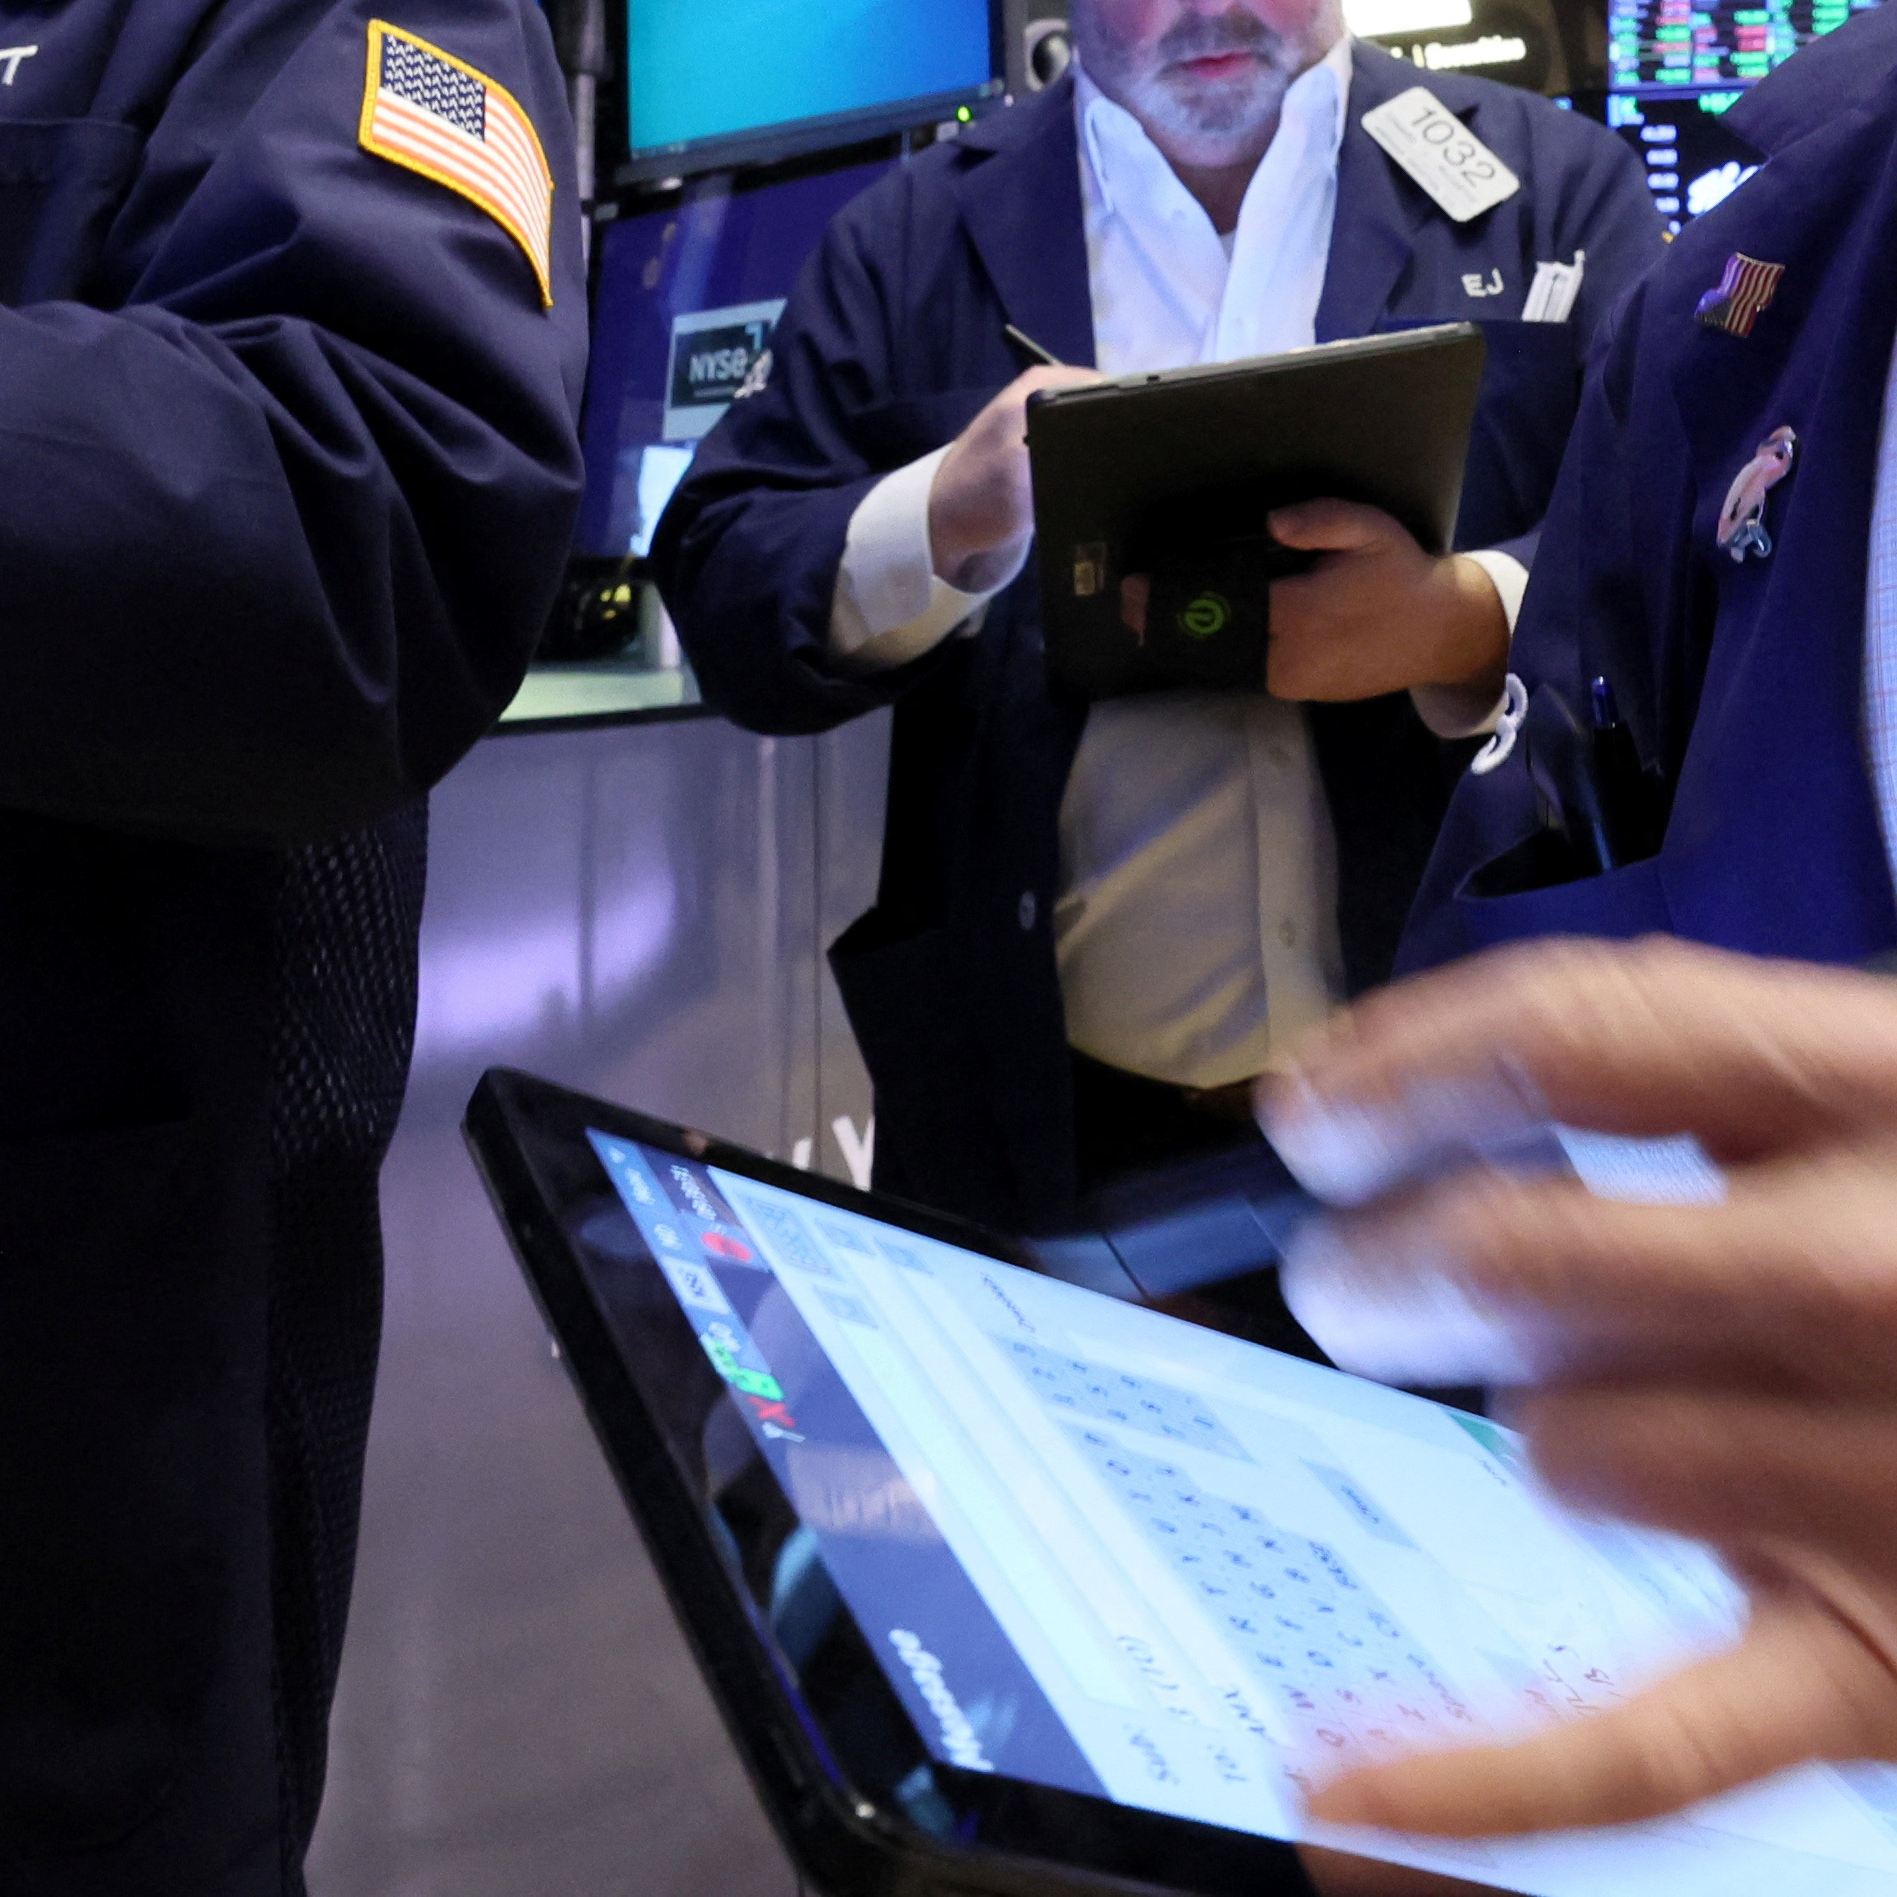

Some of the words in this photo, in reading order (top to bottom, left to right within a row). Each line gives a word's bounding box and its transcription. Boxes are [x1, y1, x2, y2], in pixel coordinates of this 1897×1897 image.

[1409, 105, 1495, 189] 1032
[1462, 268, 1504, 298] EJ
[889, 1627, 996, 1774] Message
